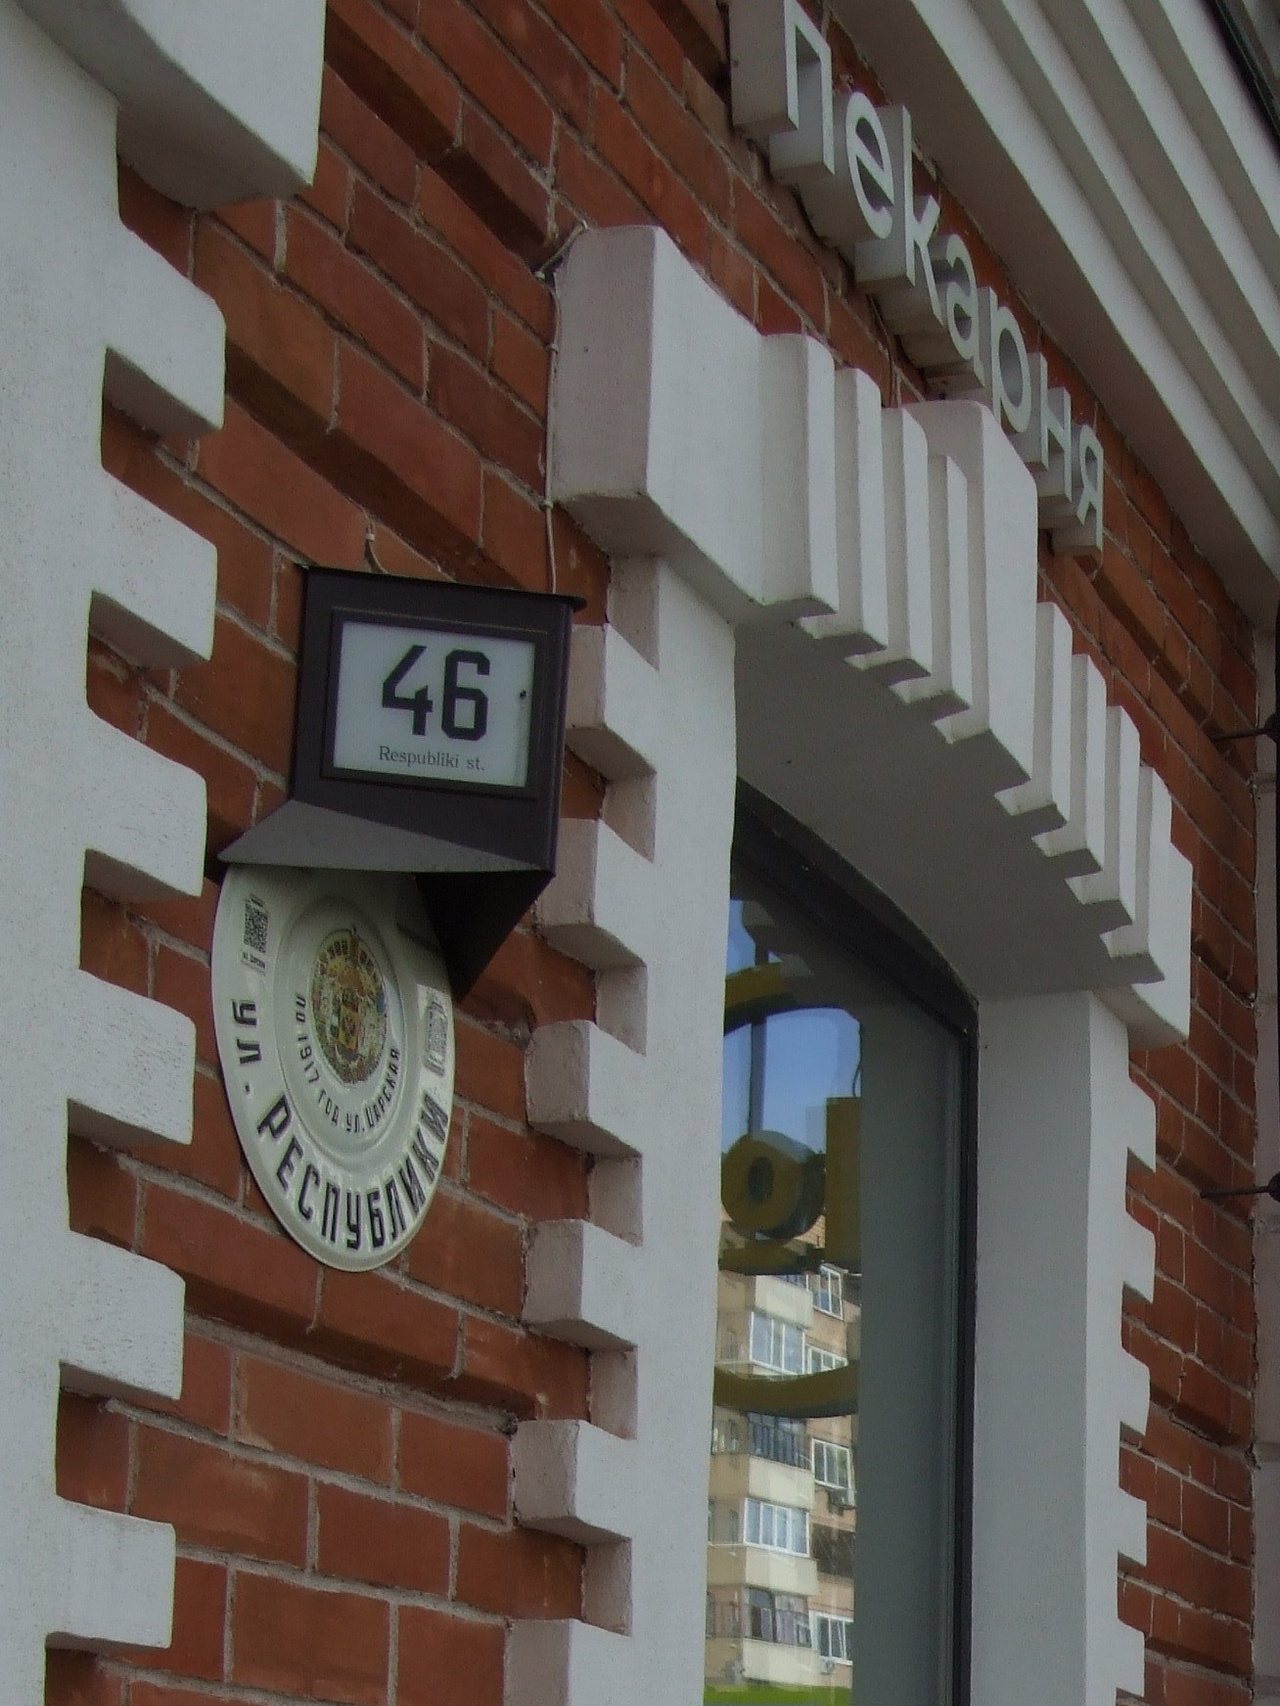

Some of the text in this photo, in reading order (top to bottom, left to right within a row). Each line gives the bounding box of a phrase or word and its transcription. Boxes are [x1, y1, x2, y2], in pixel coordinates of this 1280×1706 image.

[382, 645, 490, 741] 46
[379, 745, 485, 771] Respubliki st.
[296, 992, 306, 1023] ПО
[298, 1034, 320, 1083] 1917
[318, 1088, 339, 1125] ГОД
[365, 1048, 400, 1128] ЦАРСКАЯ
[257, 1094, 449, 1250] РЕСПУБЛИКИ
